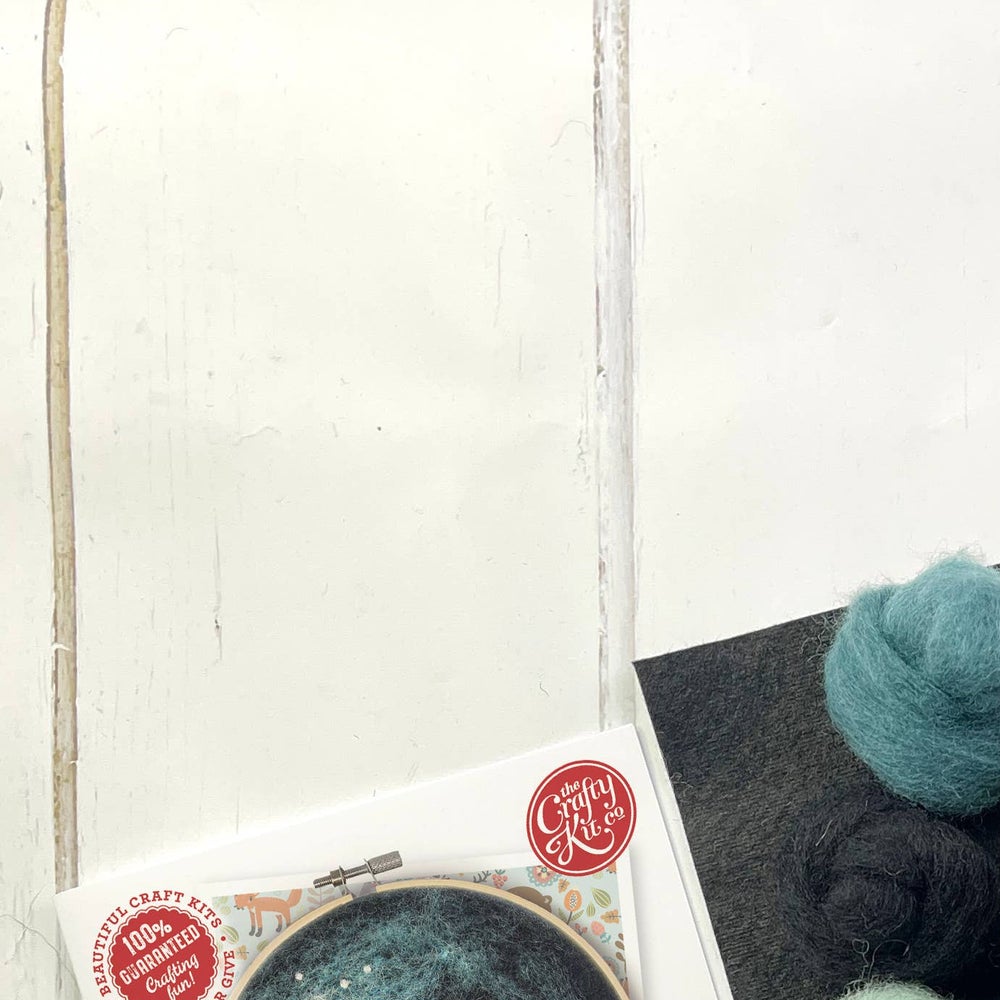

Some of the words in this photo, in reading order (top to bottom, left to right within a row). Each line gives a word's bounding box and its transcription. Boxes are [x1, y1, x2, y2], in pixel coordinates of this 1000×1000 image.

[537, 774, 616, 834] Crafty
[560, 780, 580, 798] the
[545, 813, 615, 866] Kit
[93, 906, 128, 997] BEAUTIFUL
[129, 890, 184, 908] CRAFT
[187, 896, 222, 928] KITS
[119, 924, 201, 985] GUARANTEED
[122, 920, 172, 956] 100%
[146, 953, 200, 993] Crafting
[221, 950, 235, 988] GIVE
